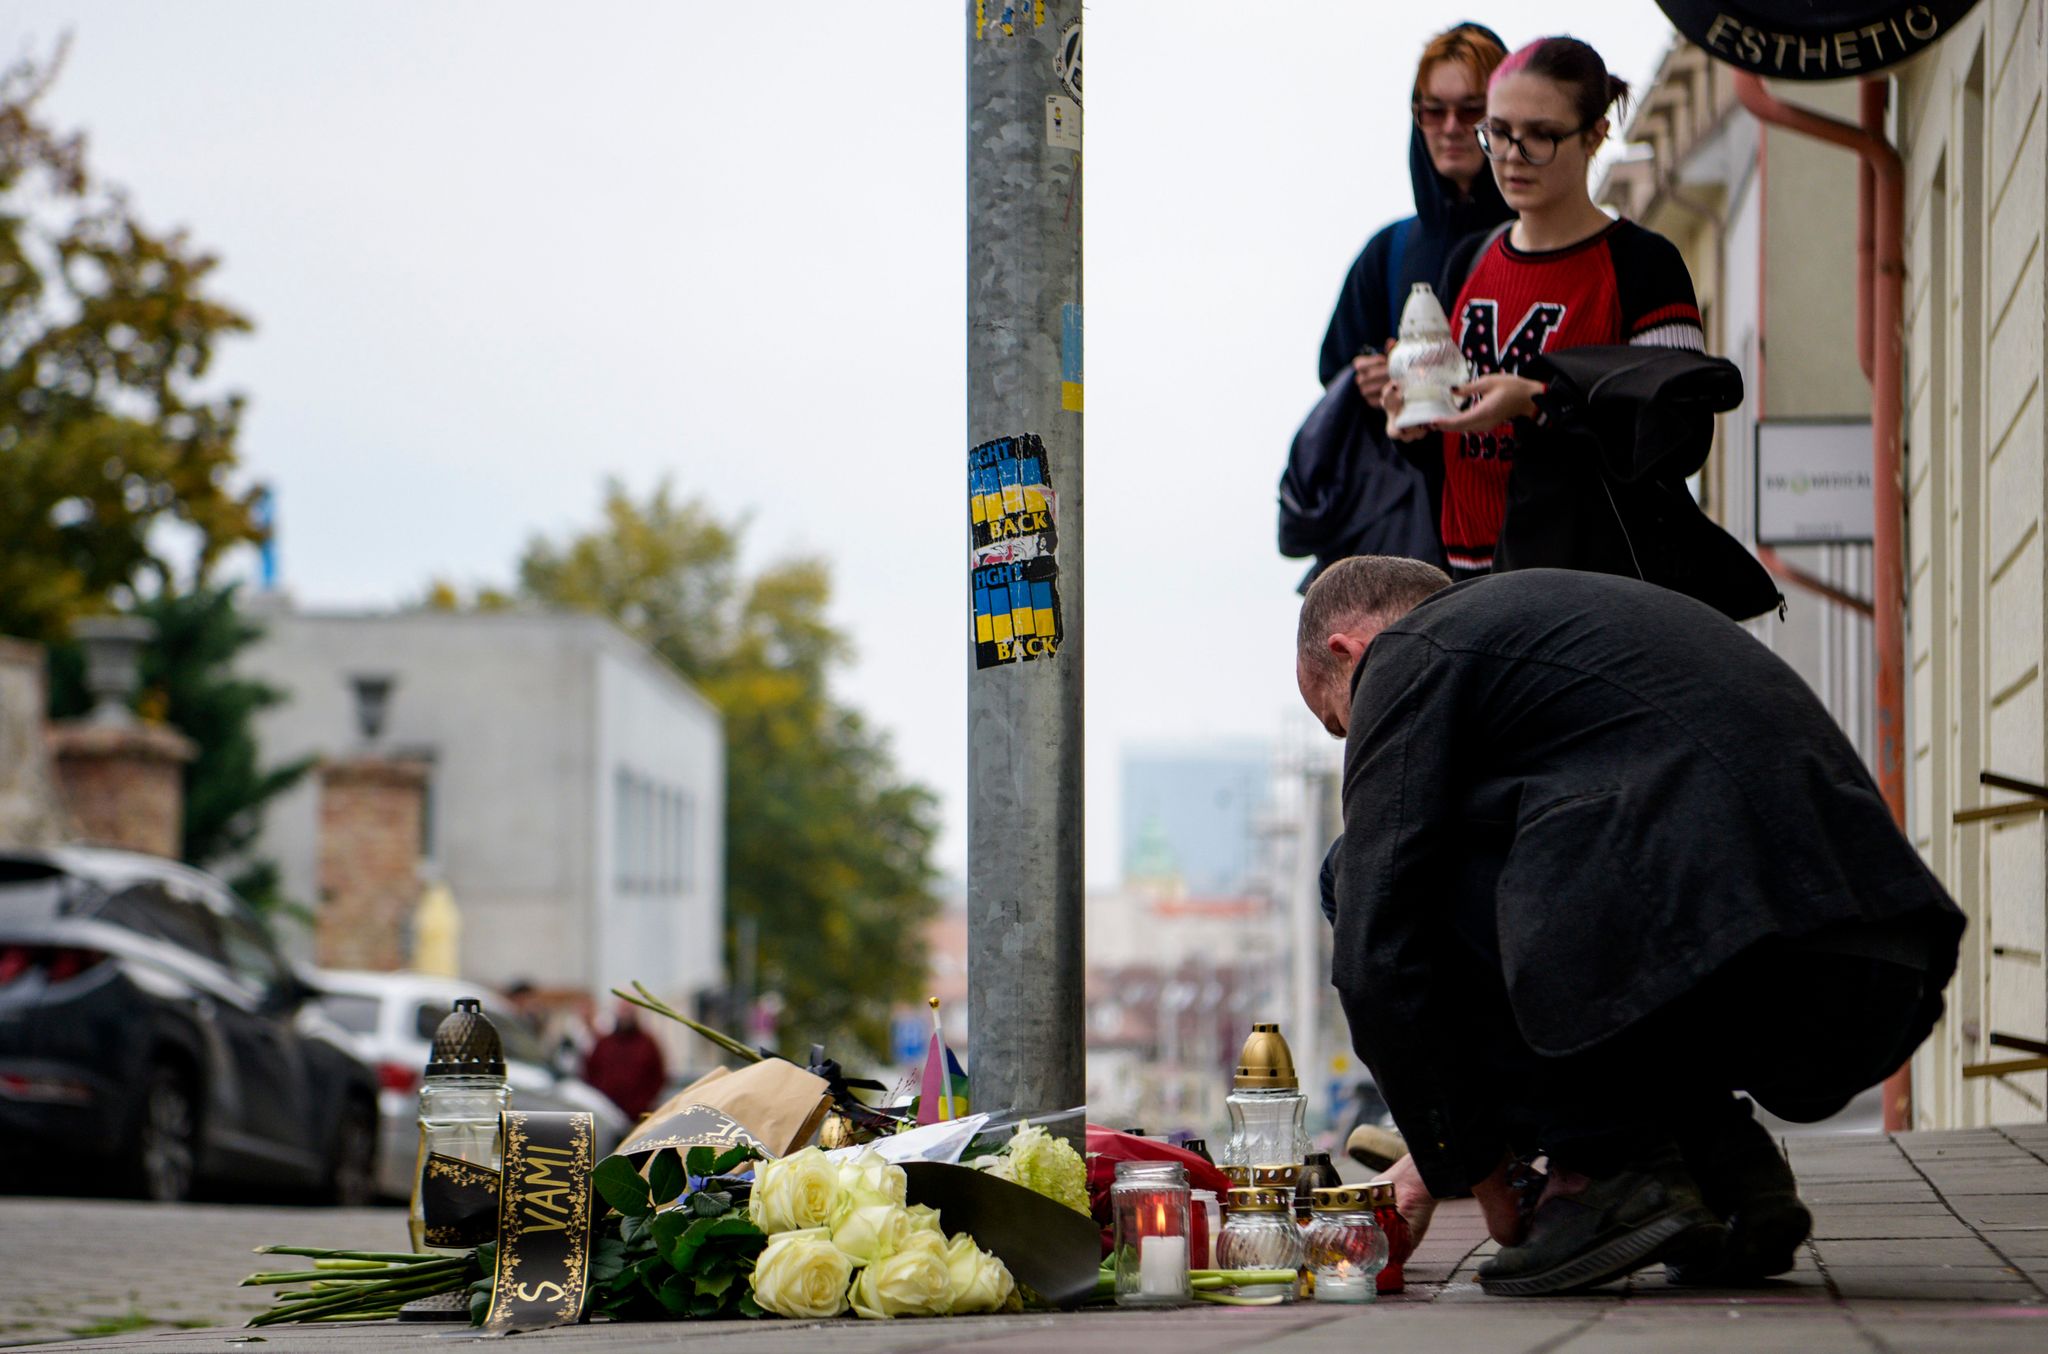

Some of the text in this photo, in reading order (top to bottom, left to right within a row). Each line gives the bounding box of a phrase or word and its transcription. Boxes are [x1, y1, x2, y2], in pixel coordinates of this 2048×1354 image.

[1706, 5, 1938, 73] ESTHETIC
[989, 511, 1049, 540] BACK
[975, 561, 1024, 589] FIGHT
[997, 636, 1057, 661] BACK
[522, 1145, 574, 1233] VAMI
